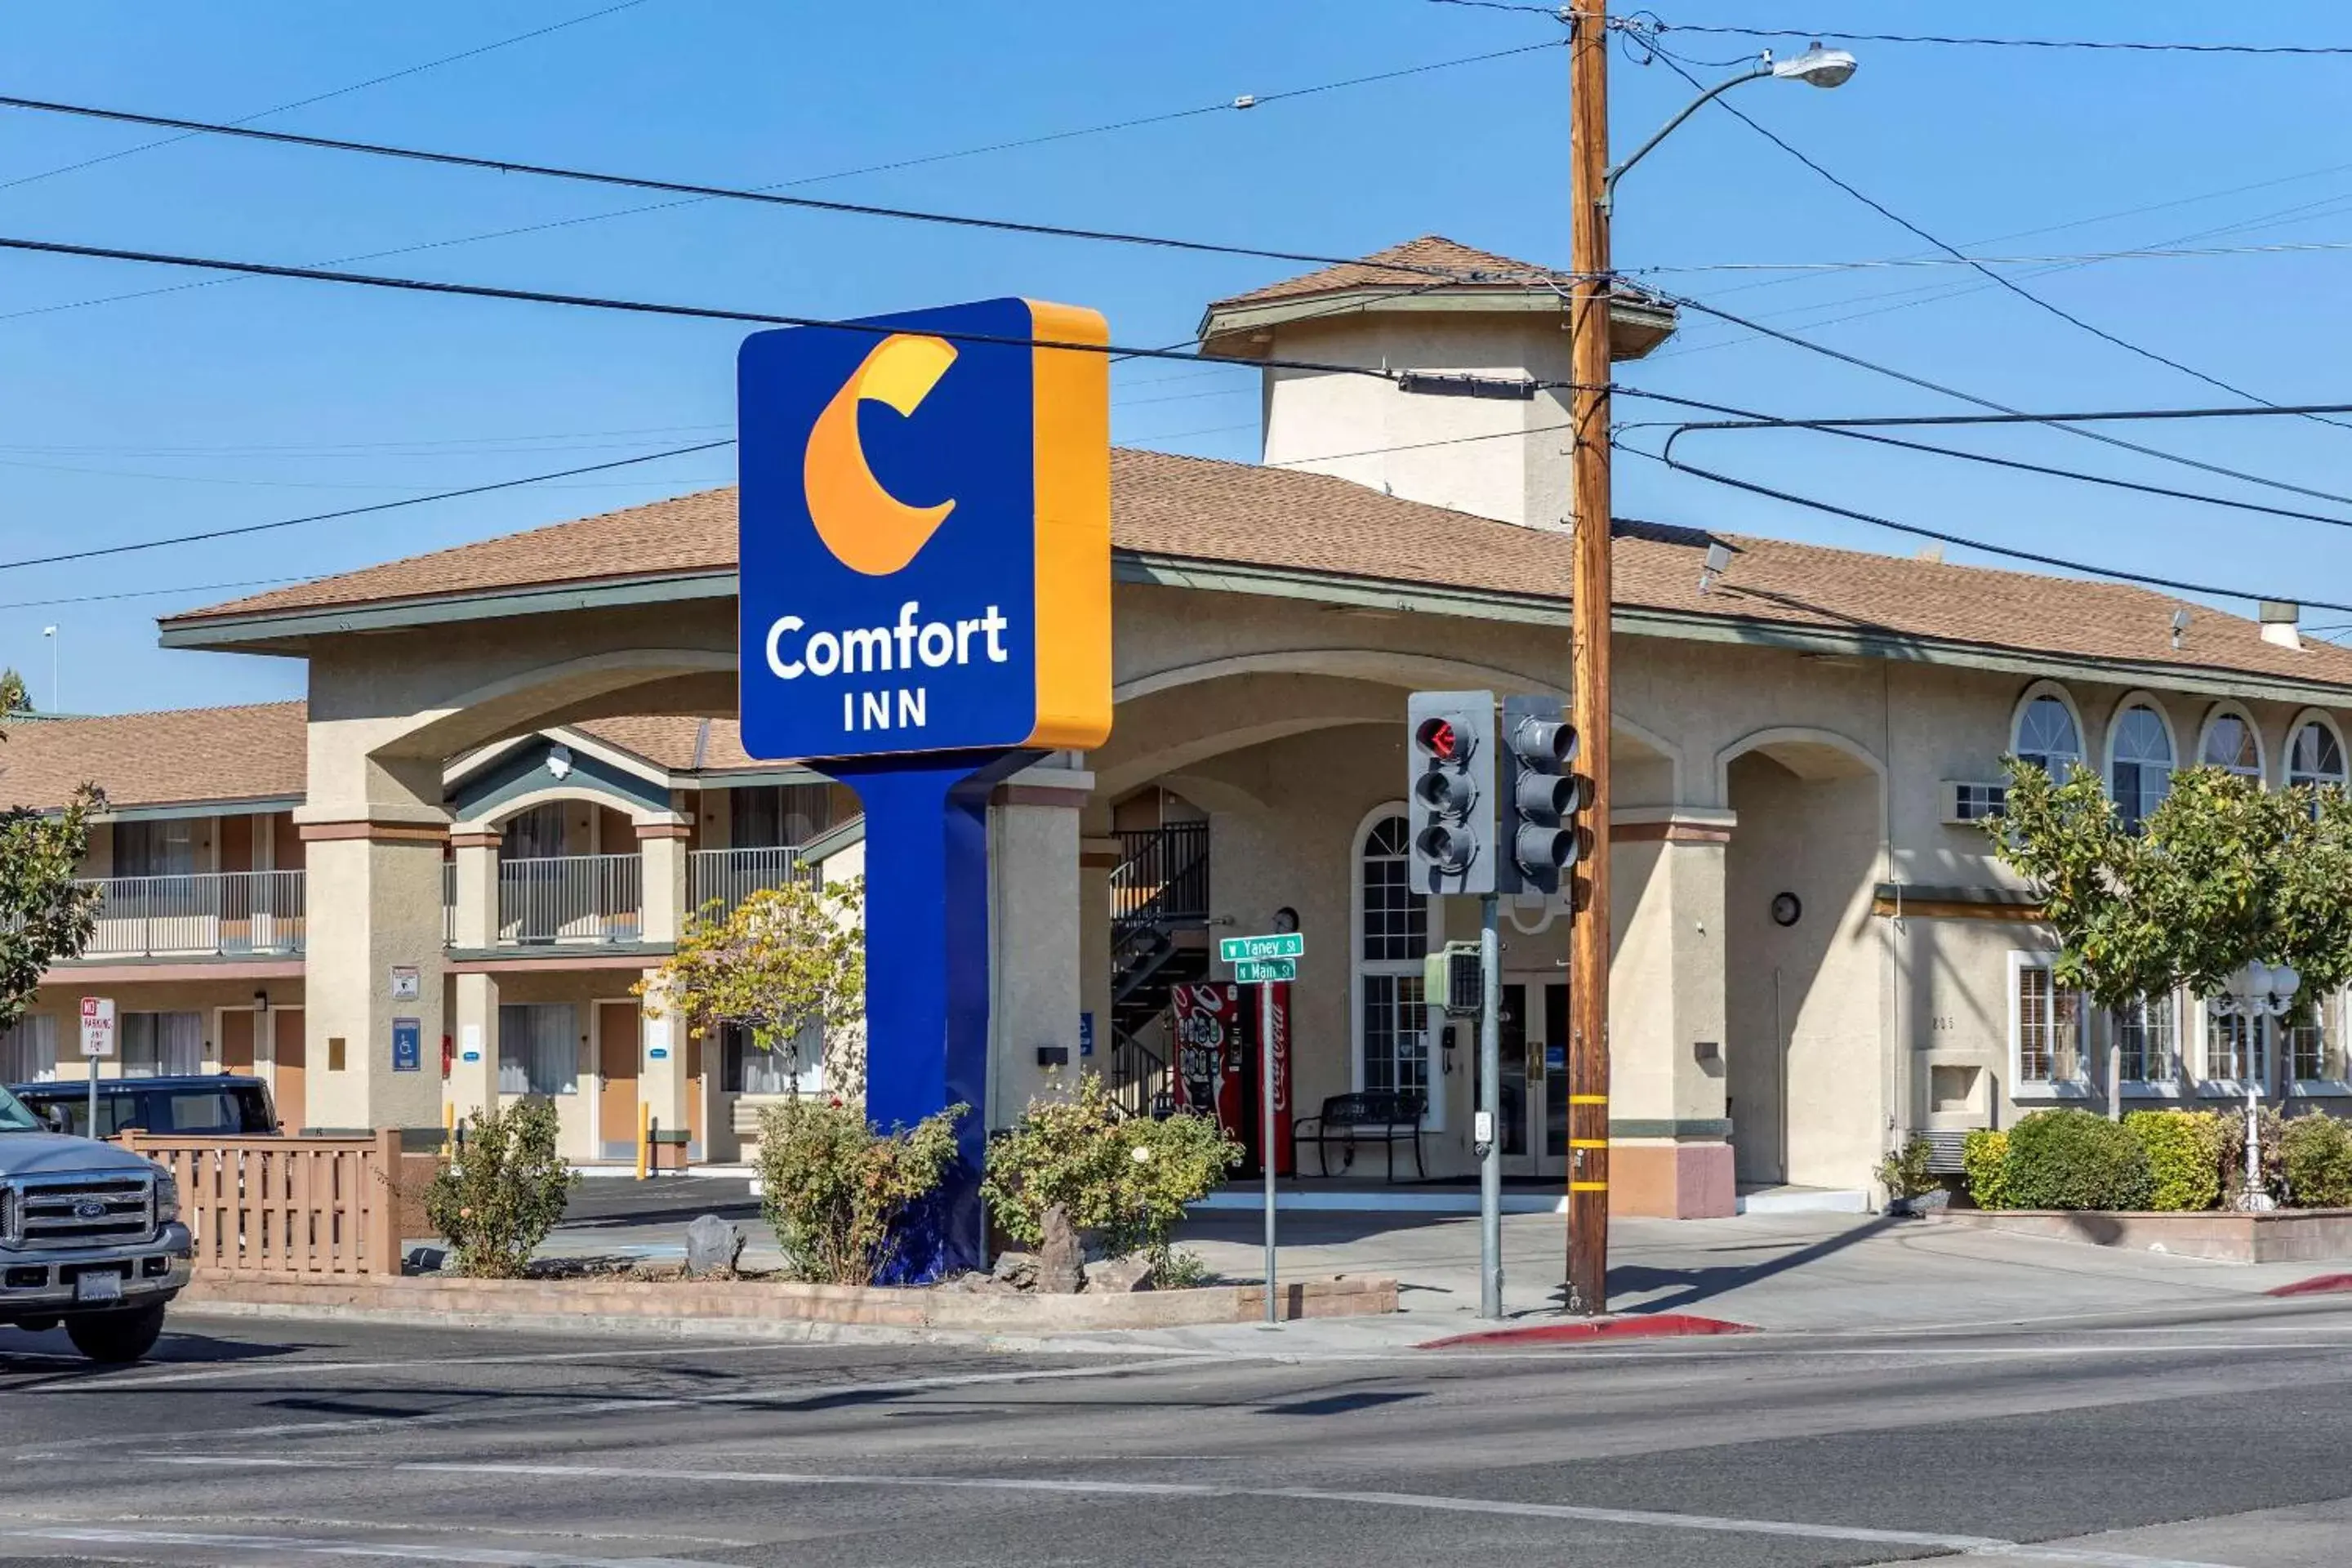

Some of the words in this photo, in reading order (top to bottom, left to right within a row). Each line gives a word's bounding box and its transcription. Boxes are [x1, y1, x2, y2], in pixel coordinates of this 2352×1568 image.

[766, 601, 1008, 679] Comfort
[844, 688, 926, 731] INN
[1229, 945, 1236, 957] W
[1244, 940, 1280, 956] Yaney
[1240, 966, 1246, 978] N
[1251, 963, 1276, 979] Main
[84, 1000, 95, 1013] NO
[84, 1018, 112, 1029] PARKING
